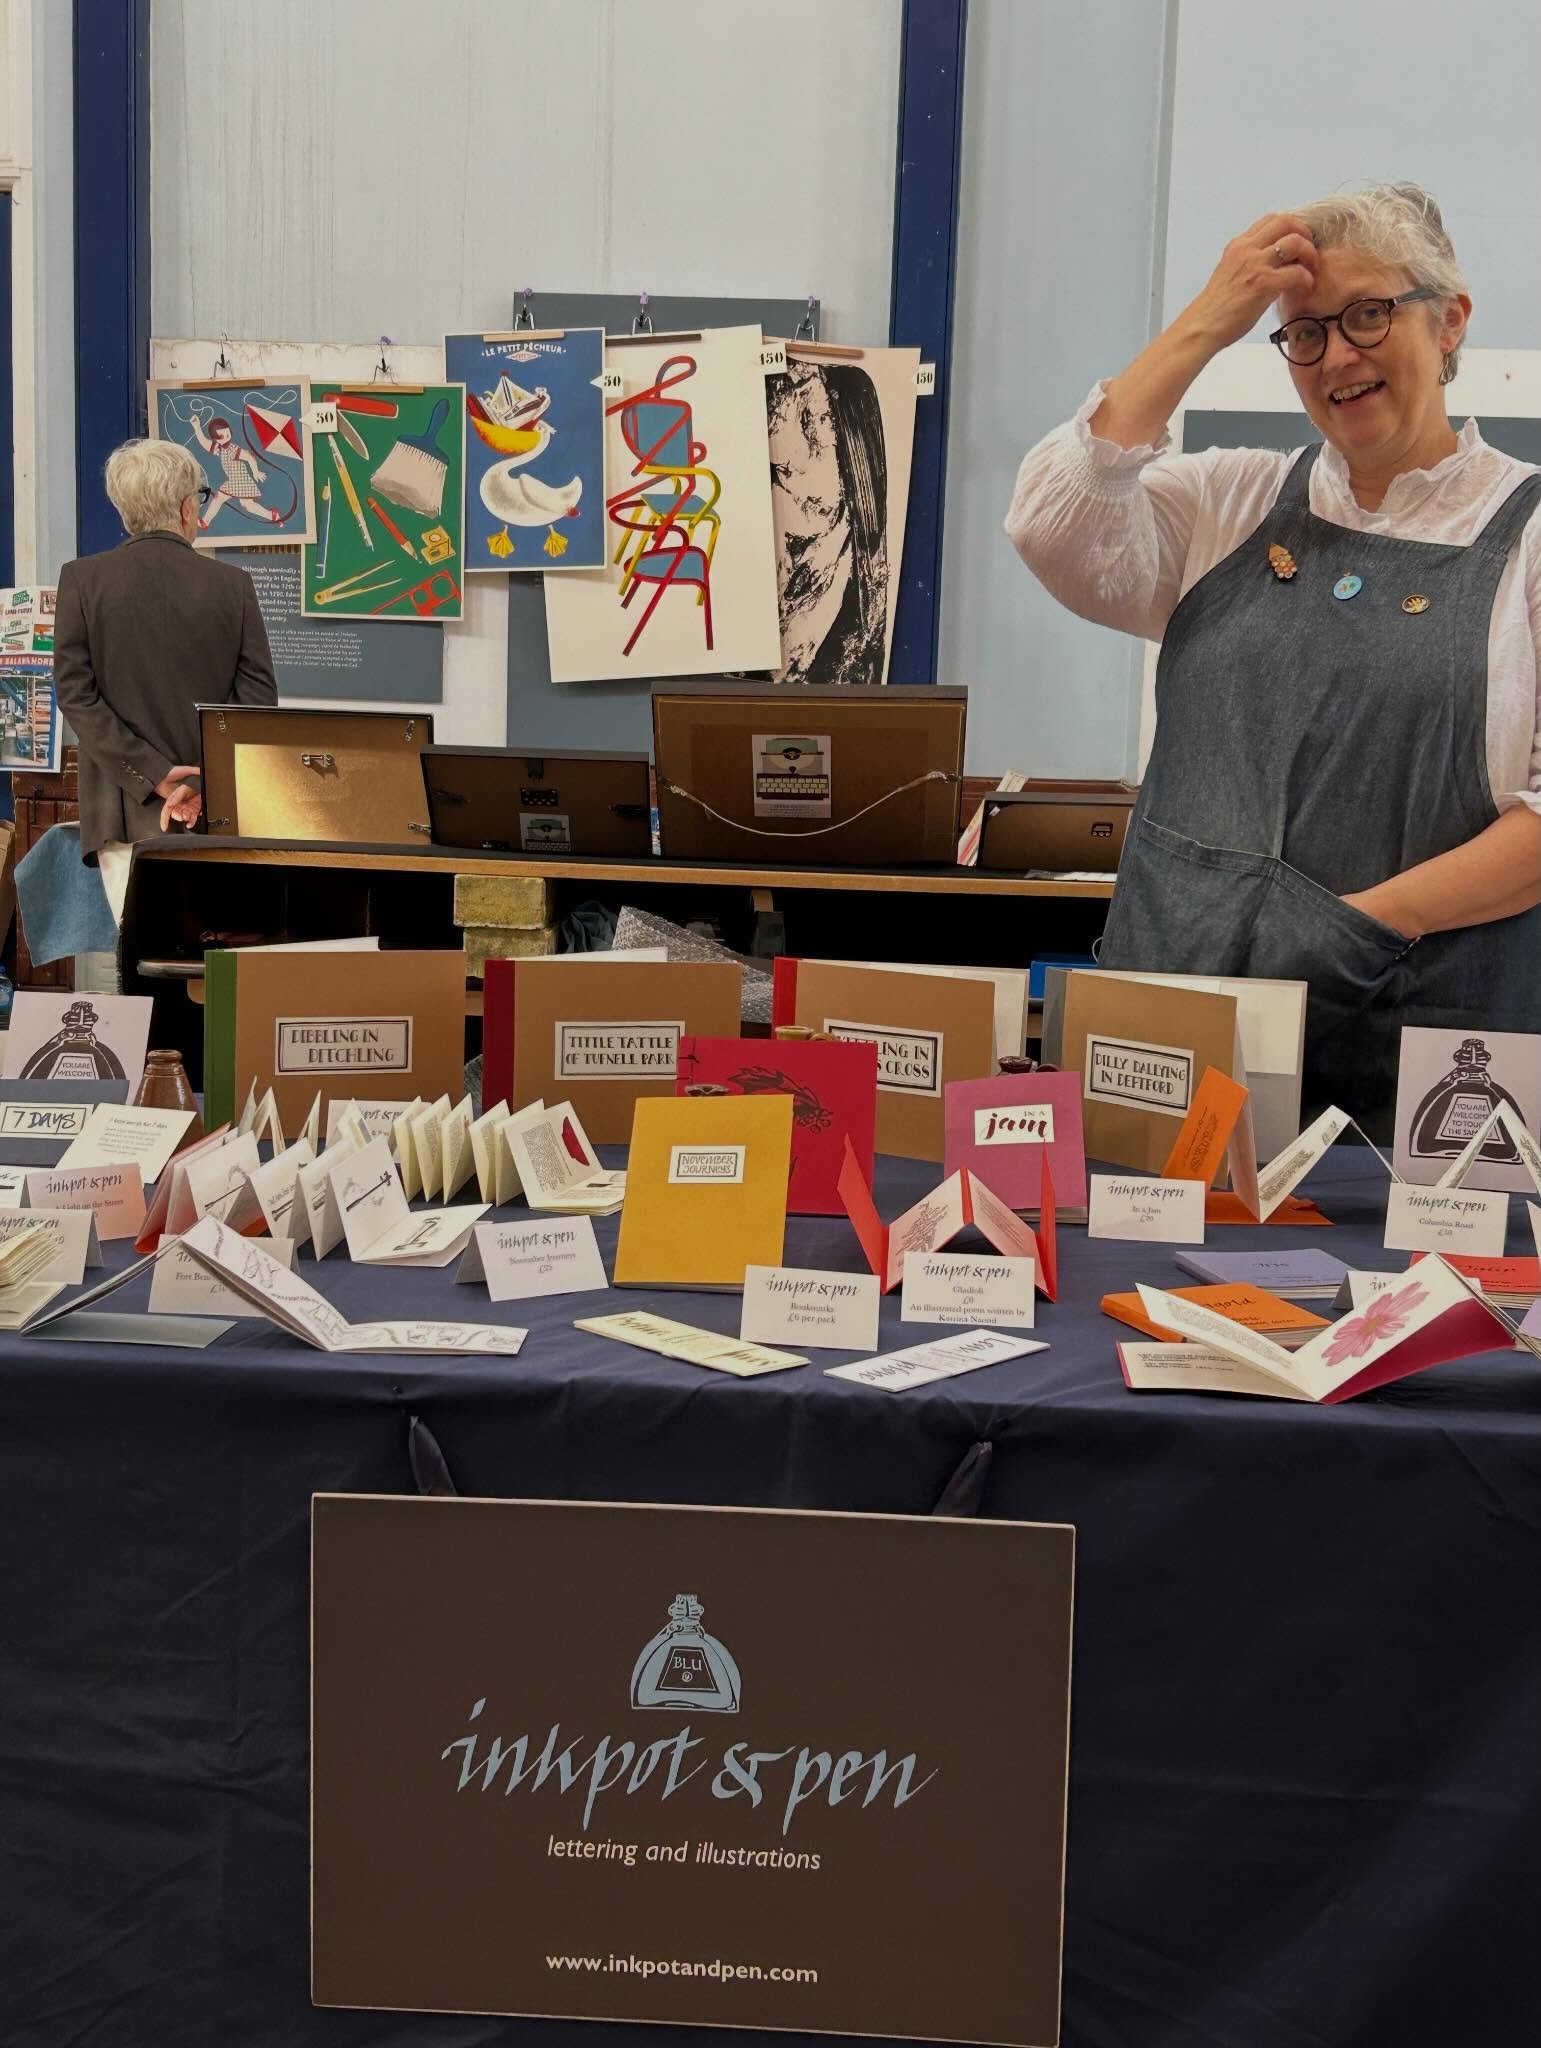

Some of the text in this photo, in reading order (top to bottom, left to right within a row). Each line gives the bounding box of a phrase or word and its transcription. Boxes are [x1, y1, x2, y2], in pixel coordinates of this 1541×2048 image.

[486, 349, 496, 357] LE
[497, 343, 521, 354] PETIT
[759, 352, 784, 365] 150
[916, 372, 933, 385] 150
[362, 1028, 379, 1042] IN
[568, 1036, 673, 1049] TITTLE TATTLE
[566, 1053, 674, 1065] OF TUFNELL PARK
[914, 1045, 929, 1060] IN
[886, 1060, 930, 1079] CROSS
[1096, 1053, 1186, 1081] DILLY DALLYING
[1101, 1070, 1112, 1084] IN
[13, 1110, 26, 1128] 7
[982, 1113, 1048, 1140] jam
[1464, 1120, 1484, 1128] TOUC
[682, 1155, 734, 1164] NOVEMBER
[46, 1174, 122, 1197] inkpot & pen
[1107, 1180, 1185, 1200] inkpot & pen
[1407, 1190, 1488, 1215] inkpot & pen
[497, 1231, 577, 1252] inkpot & pen
[923, 1259, 1012, 1284] inkpot & pen
[766, 1274, 860, 1300] inkpot & pen
[790, 1302, 834, 1313] Bookmarks
[924, 1304, 962, 1313] illustrated
[963, 1306, 985, 1315] poem
[987, 1307, 1014, 1315] written
[1016, 1308, 1026, 1317] by
[802, 1314, 815, 1324] per
[817, 1316, 836, 1325] pack
[672, 1656, 702, 1671] BLU
[442, 1697, 938, 1836] inkpot & pen
[548, 1834, 821, 1870] lettering and illustrations
[546, 1954, 818, 1983] www.inkpotandpen.com
